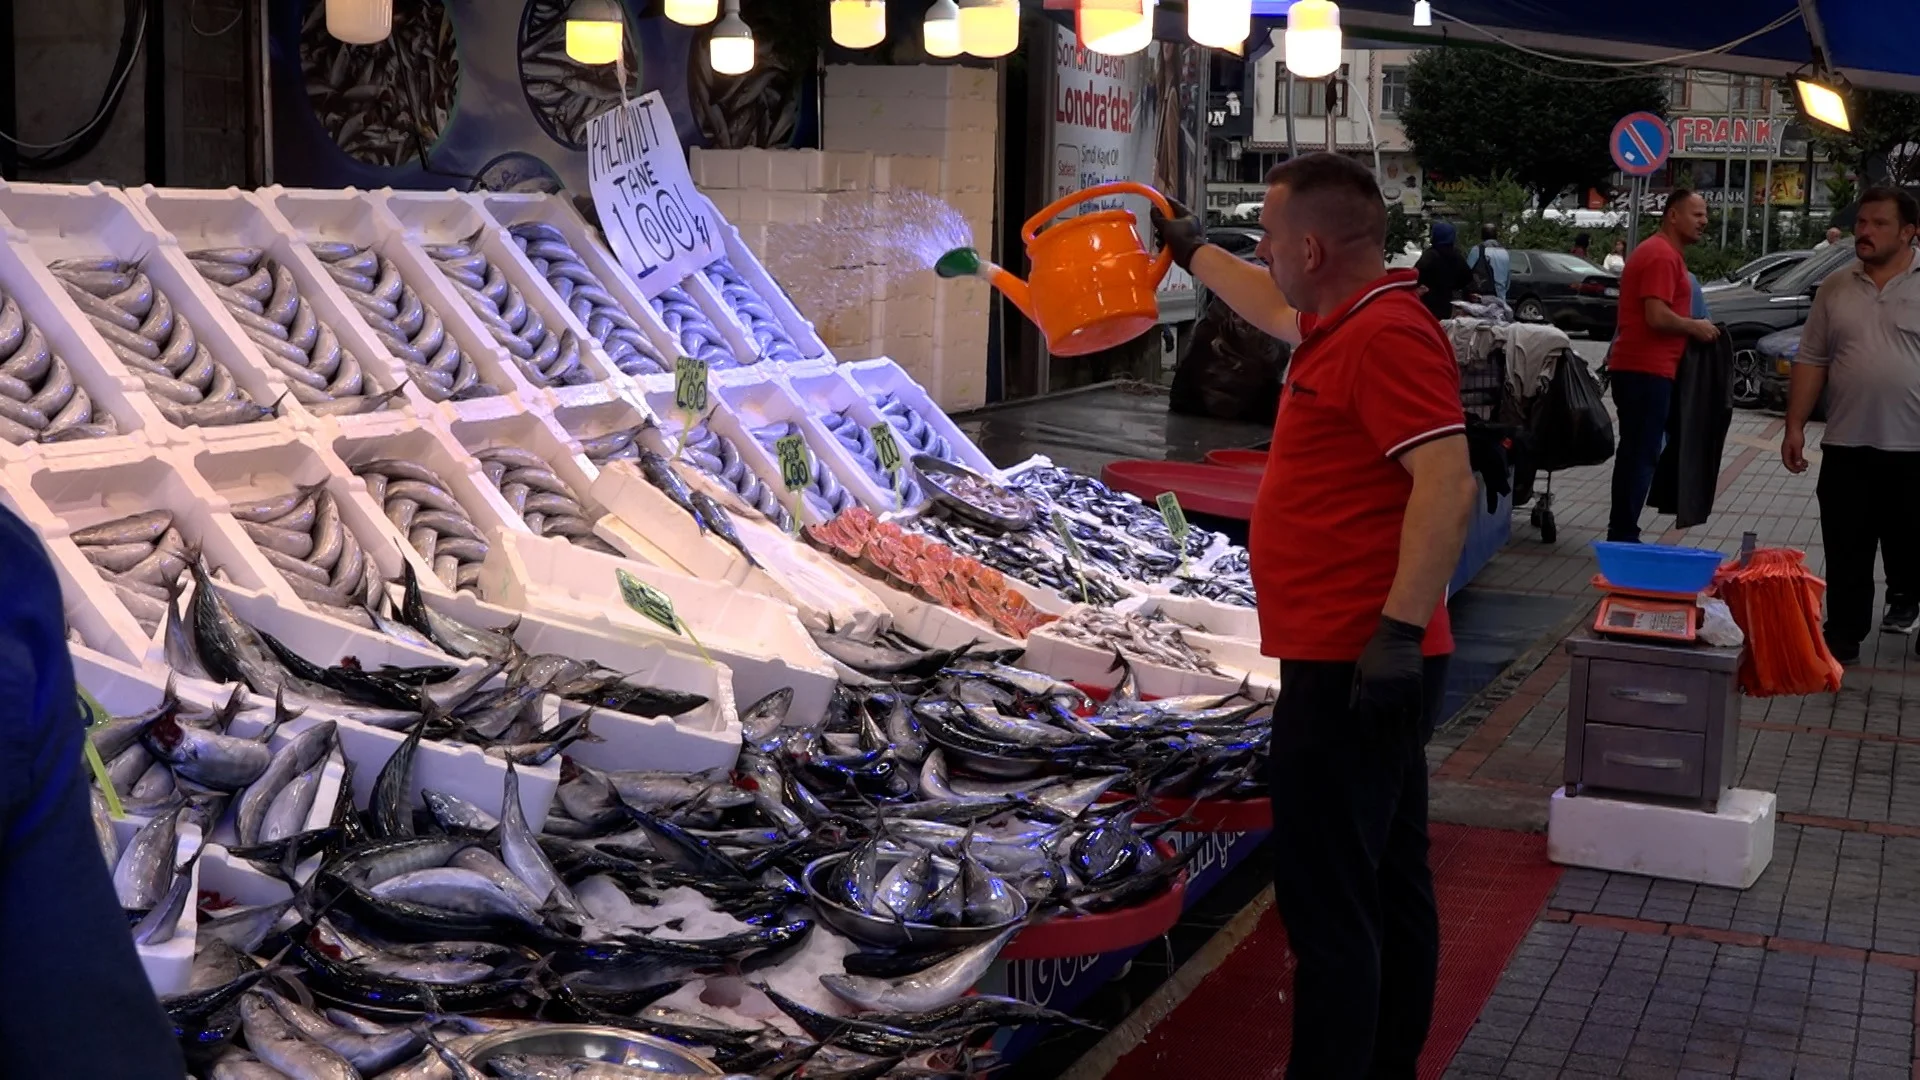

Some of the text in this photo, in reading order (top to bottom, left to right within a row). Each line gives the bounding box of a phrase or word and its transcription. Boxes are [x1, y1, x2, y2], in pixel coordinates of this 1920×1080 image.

[1056, 73, 1133, 134] Londra'da!
[1677, 116, 1777, 152] FRANK
[612, 161, 660, 207] TANE
